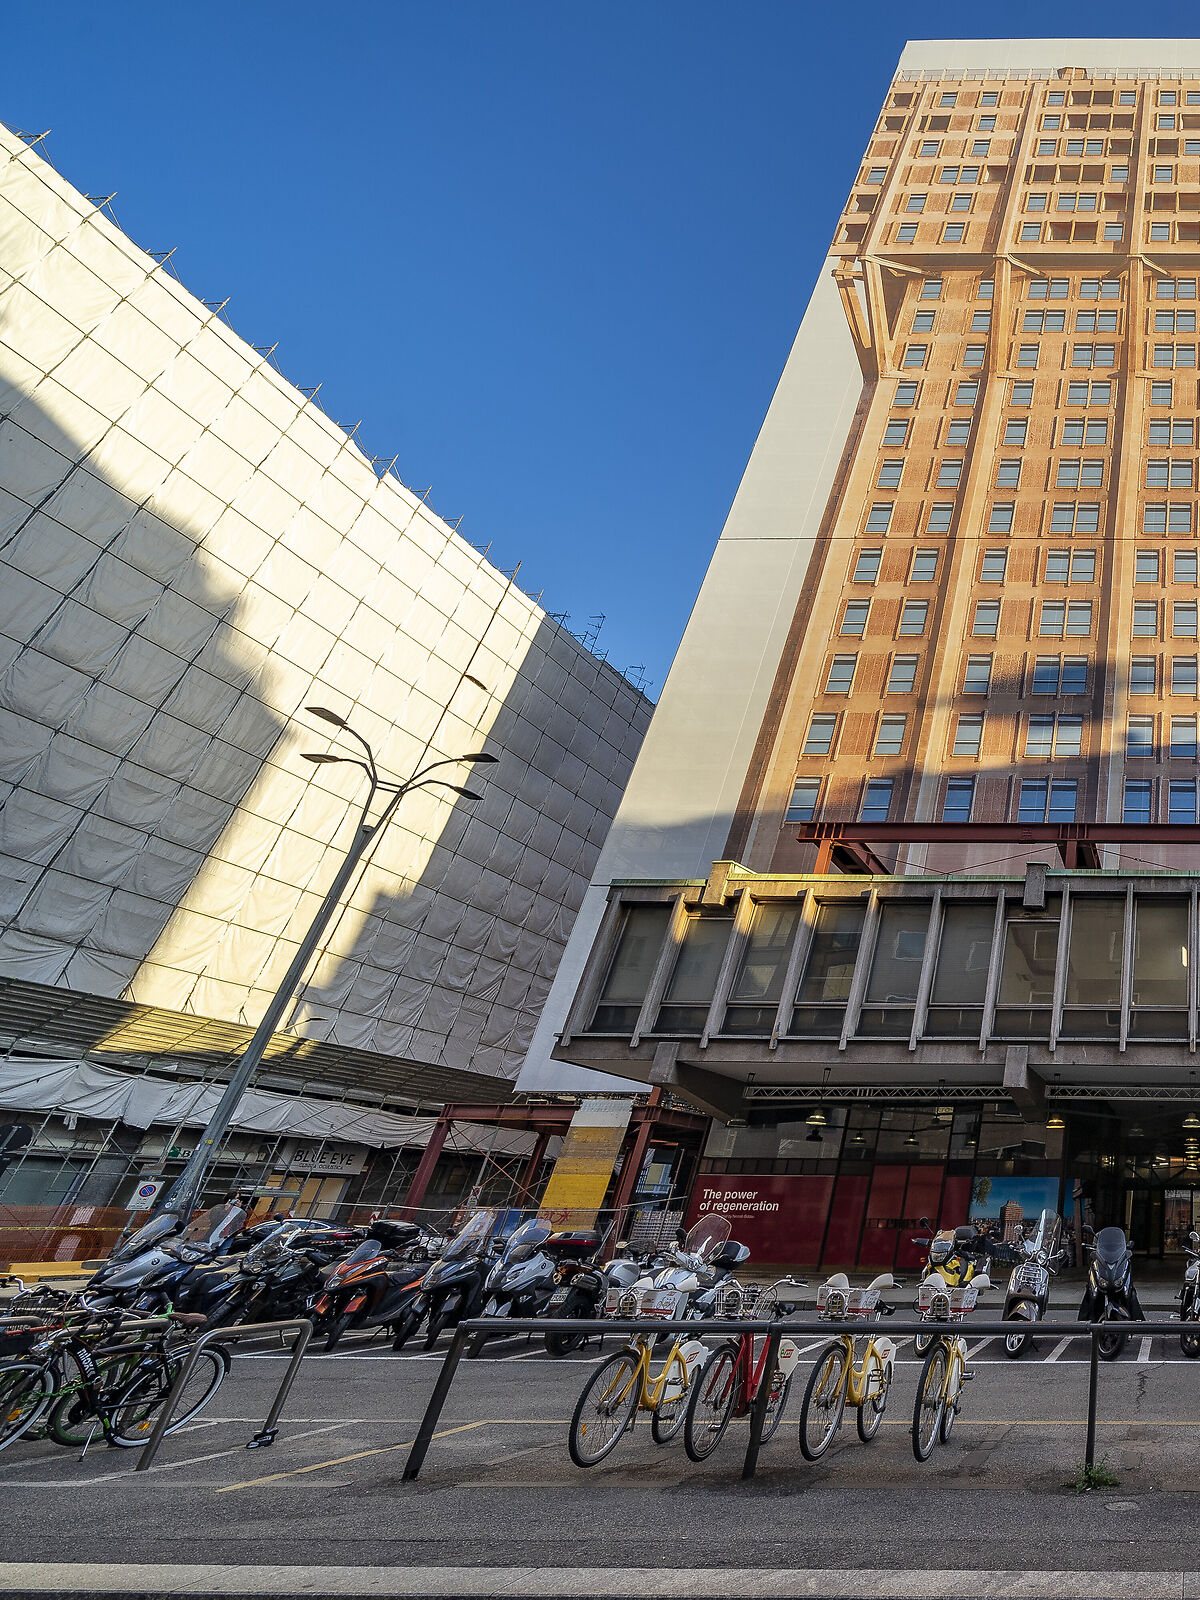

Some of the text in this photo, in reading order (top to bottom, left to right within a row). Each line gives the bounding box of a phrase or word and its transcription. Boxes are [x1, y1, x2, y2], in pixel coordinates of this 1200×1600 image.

[294, 1150, 356, 1165] BLUE EYE
[703, 1189, 758, 1201] The power
[699, 1201, 779, 1213] of regeneration
